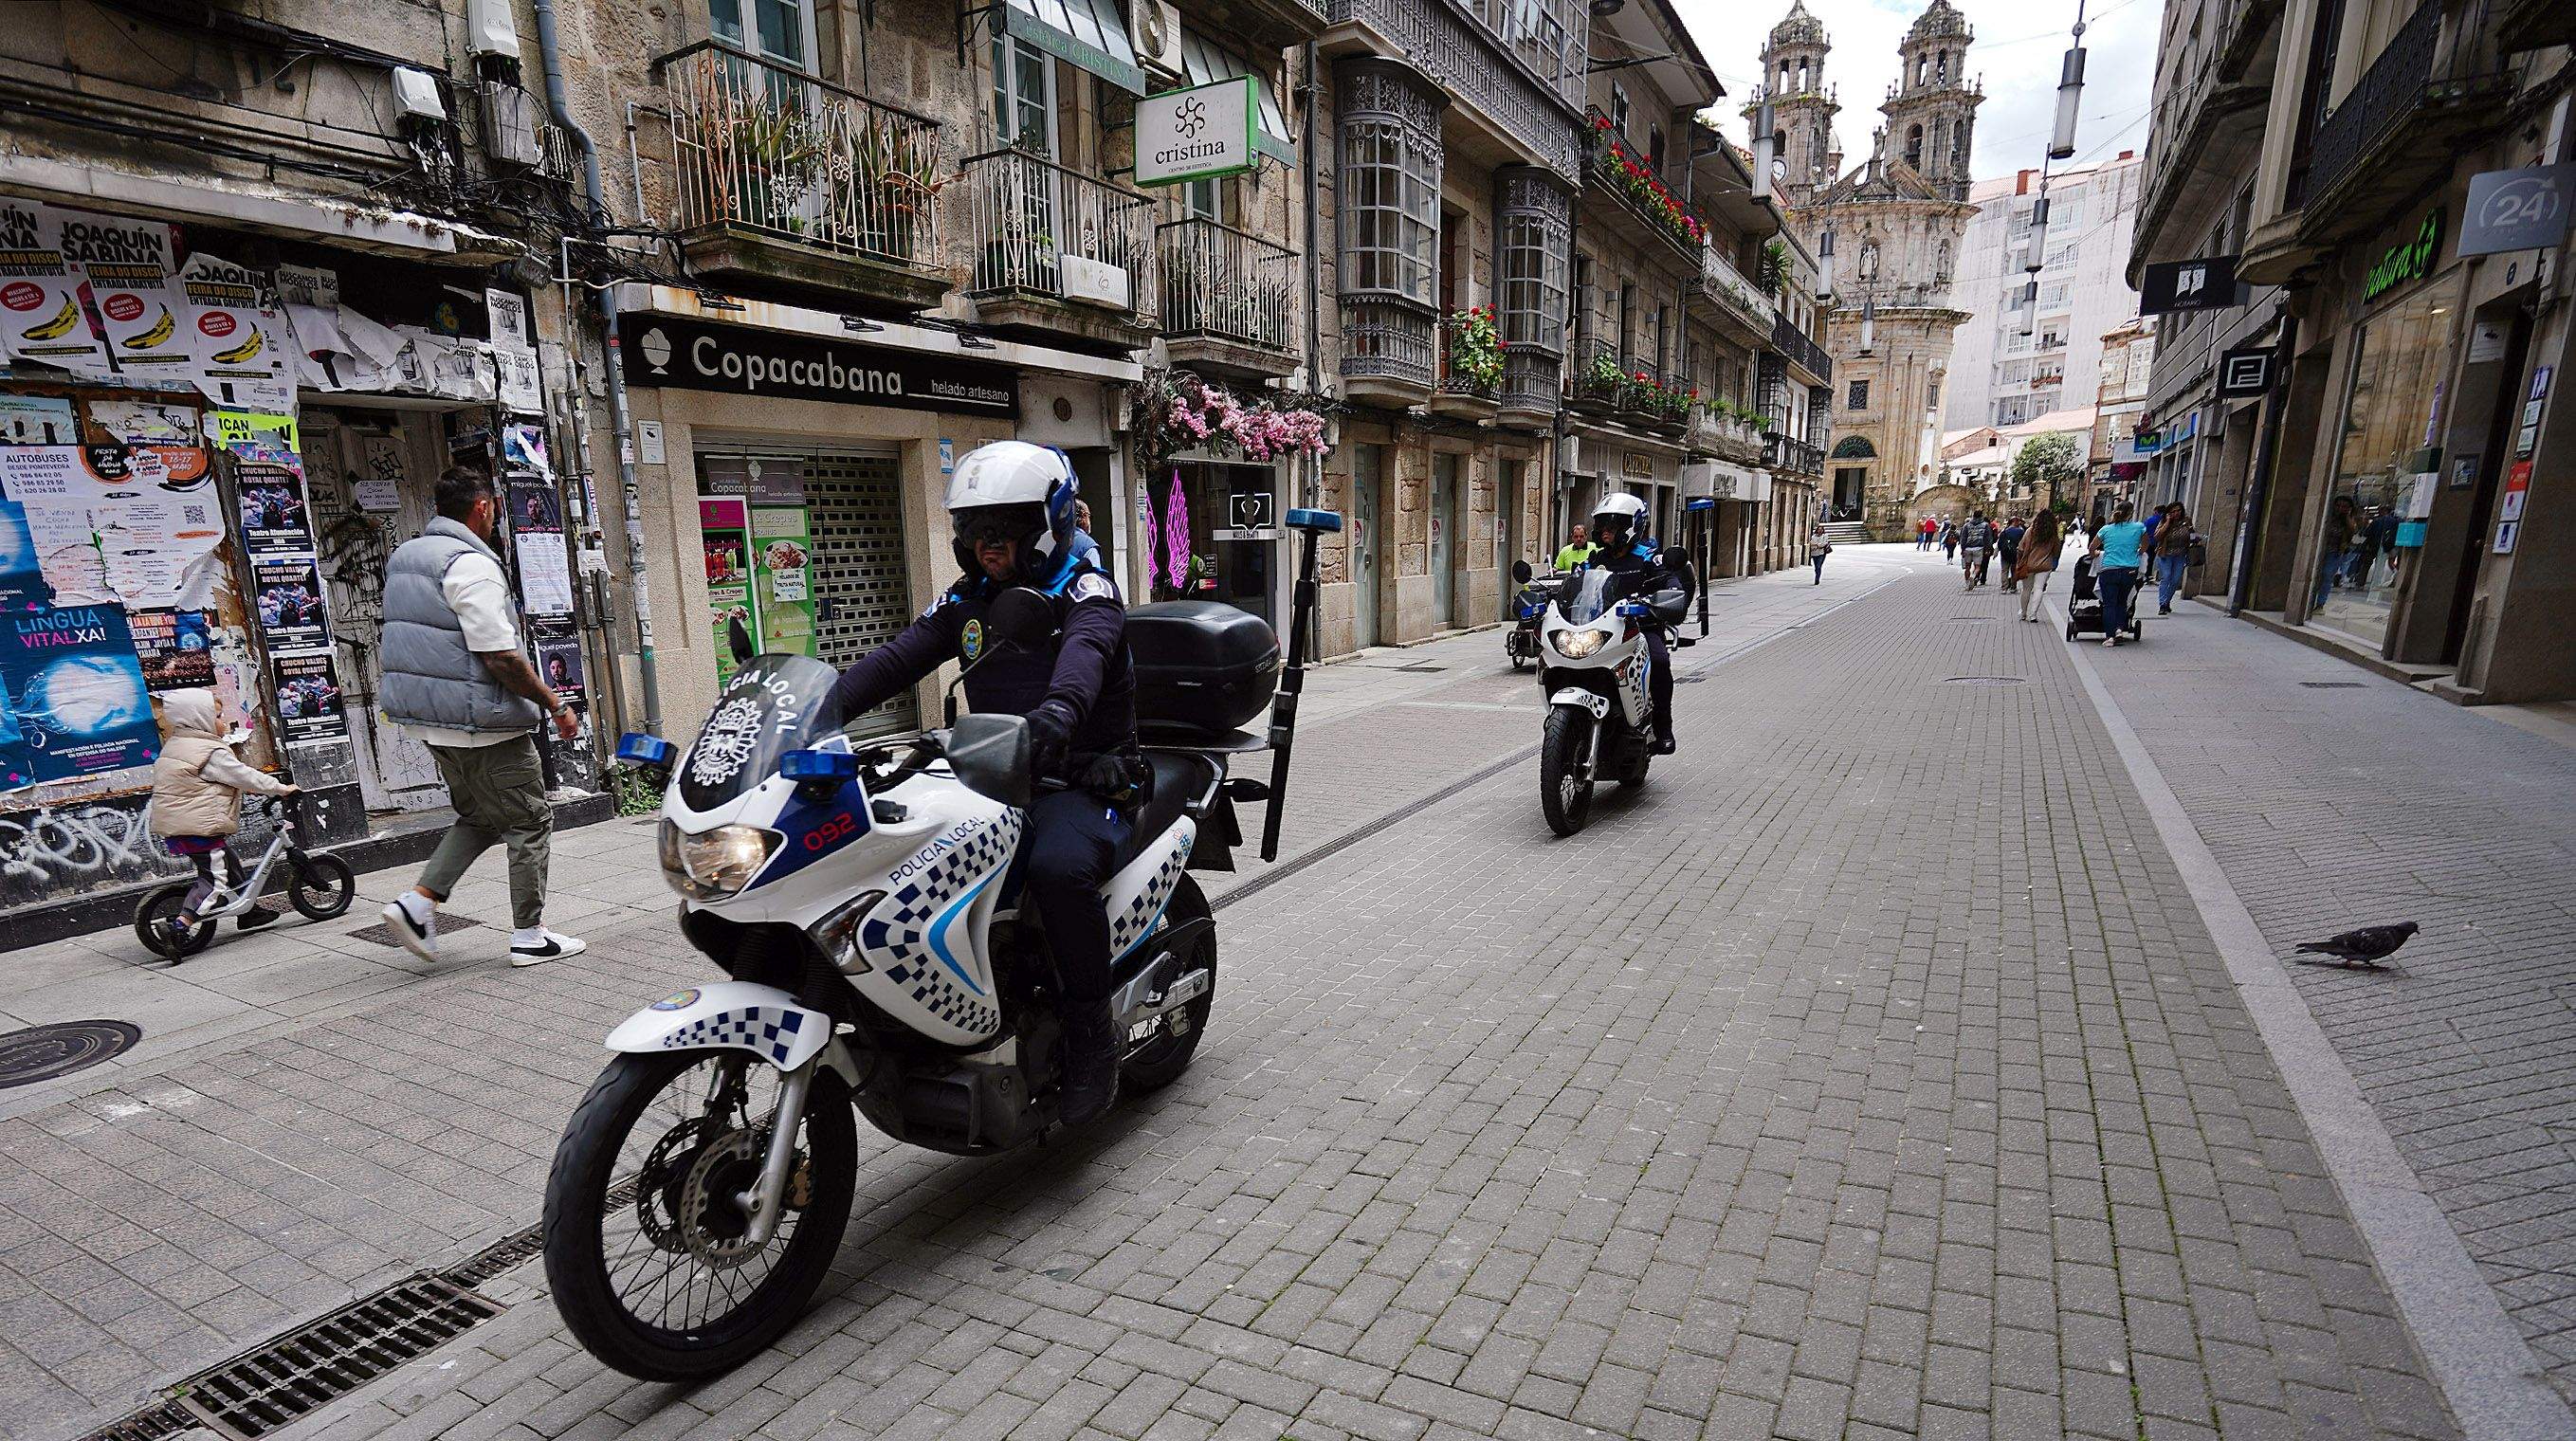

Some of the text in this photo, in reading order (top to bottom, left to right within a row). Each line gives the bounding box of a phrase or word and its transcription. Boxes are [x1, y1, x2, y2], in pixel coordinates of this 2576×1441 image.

[1072, 42, 1131, 84] CRISTINA
[1155, 138, 1225, 164] cristina
[2493, 191, 2546, 227] 24
[61, 222, 163, 251] JOAQUÍN
[28, 253, 62, 265] DISCO
[62, 239, 167, 273] SABINA
[89, 265, 116, 277] FEIRA
[117, 266, 130, 277] DO
[132, 267, 161, 278] DISCO
[92, 280, 165, 289] ENTRADA GRATUITA
[188, 284, 253, 298] FEIRA DO DISCO
[190, 296, 223, 306] ENTRADA
[223, 299, 257, 309] GRATUITA
[691, 336, 903, 395] Copacabana
[931, 379, 1010, 402] helado artesano
[7, 454, 69, 464] AUTOBUSES
[240, 466, 266, 475] CHUCHO
[258, 566, 283, 575] CHUCHO
[15, 610, 101, 632] LINGUA
[281, 658, 305, 666] CHUCHO
[283, 666, 327, 676] ROYAL QUARTET
[762, 671, 797, 734] LOCAL
[286, 718, 307, 726] Teatro
[803, 812, 857, 851] 092
[888, 814, 986, 886] POLICIA LOCAL
